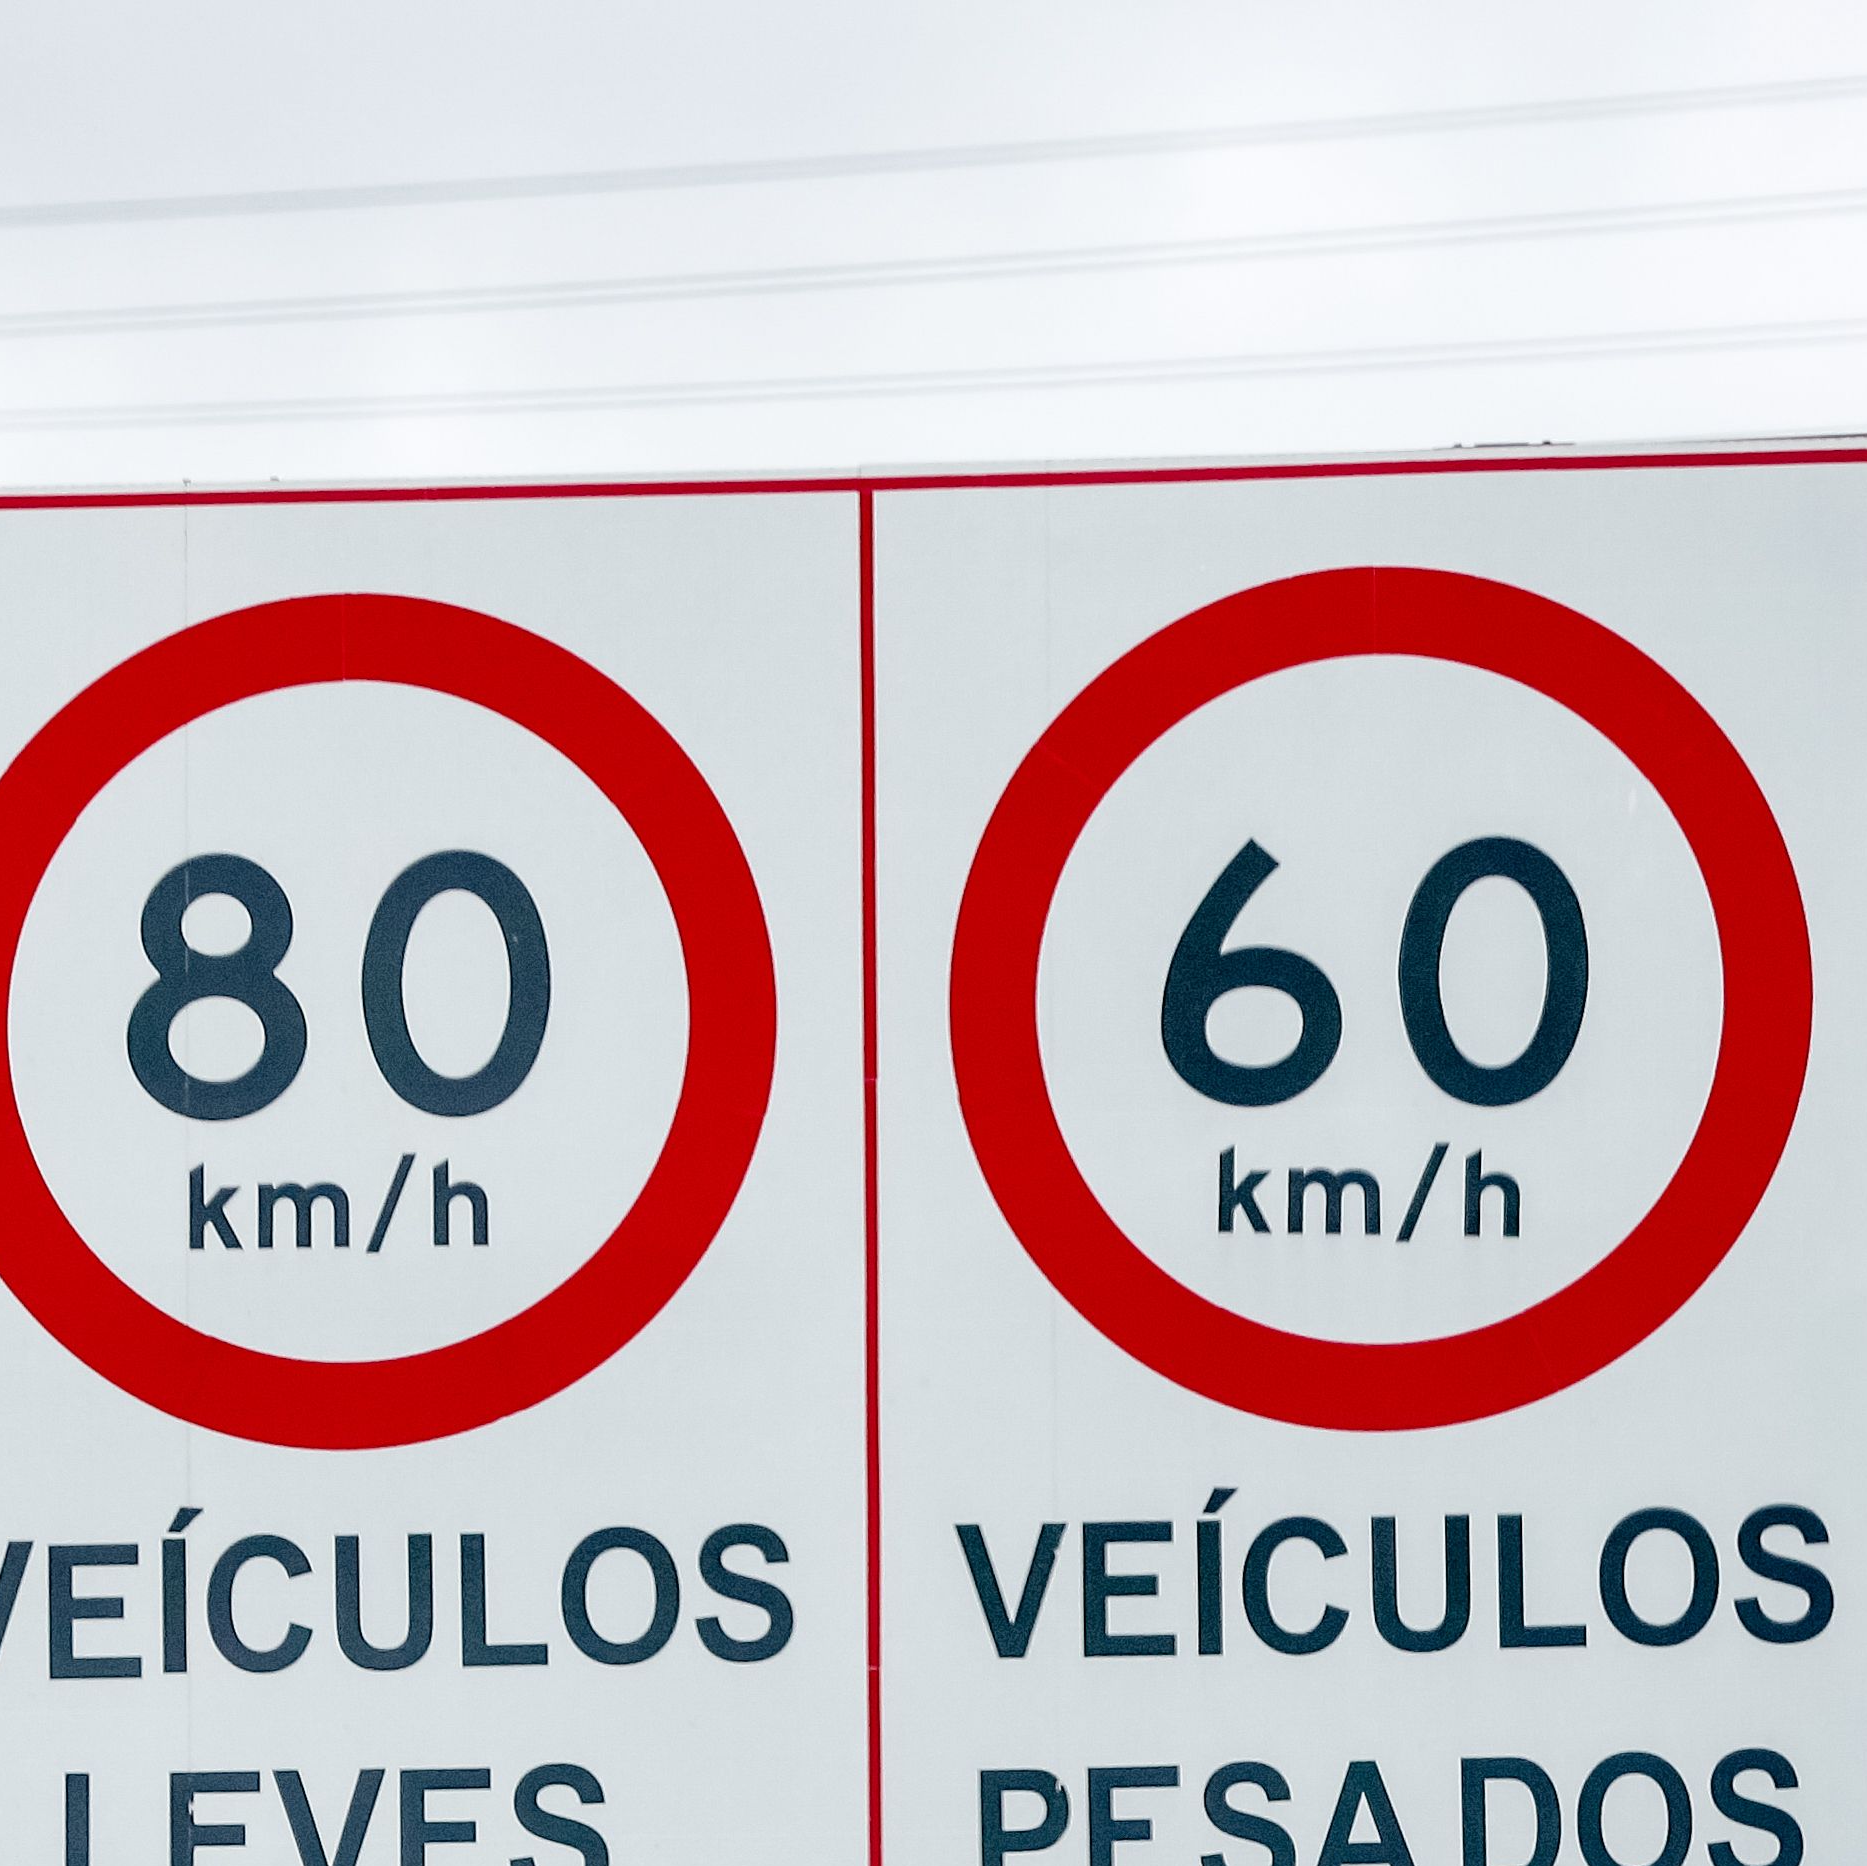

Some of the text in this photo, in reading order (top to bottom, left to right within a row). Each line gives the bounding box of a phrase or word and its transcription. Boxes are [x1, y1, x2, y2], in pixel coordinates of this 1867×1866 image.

[126, 849, 552, 1122] 80
[1160, 835, 1590, 1108] 60
[188, 1153, 490, 1255] km/h
[1216, 1142, 1522, 1243] km/h
[953, 1486, 1836, 1660] VEÍCULOS
